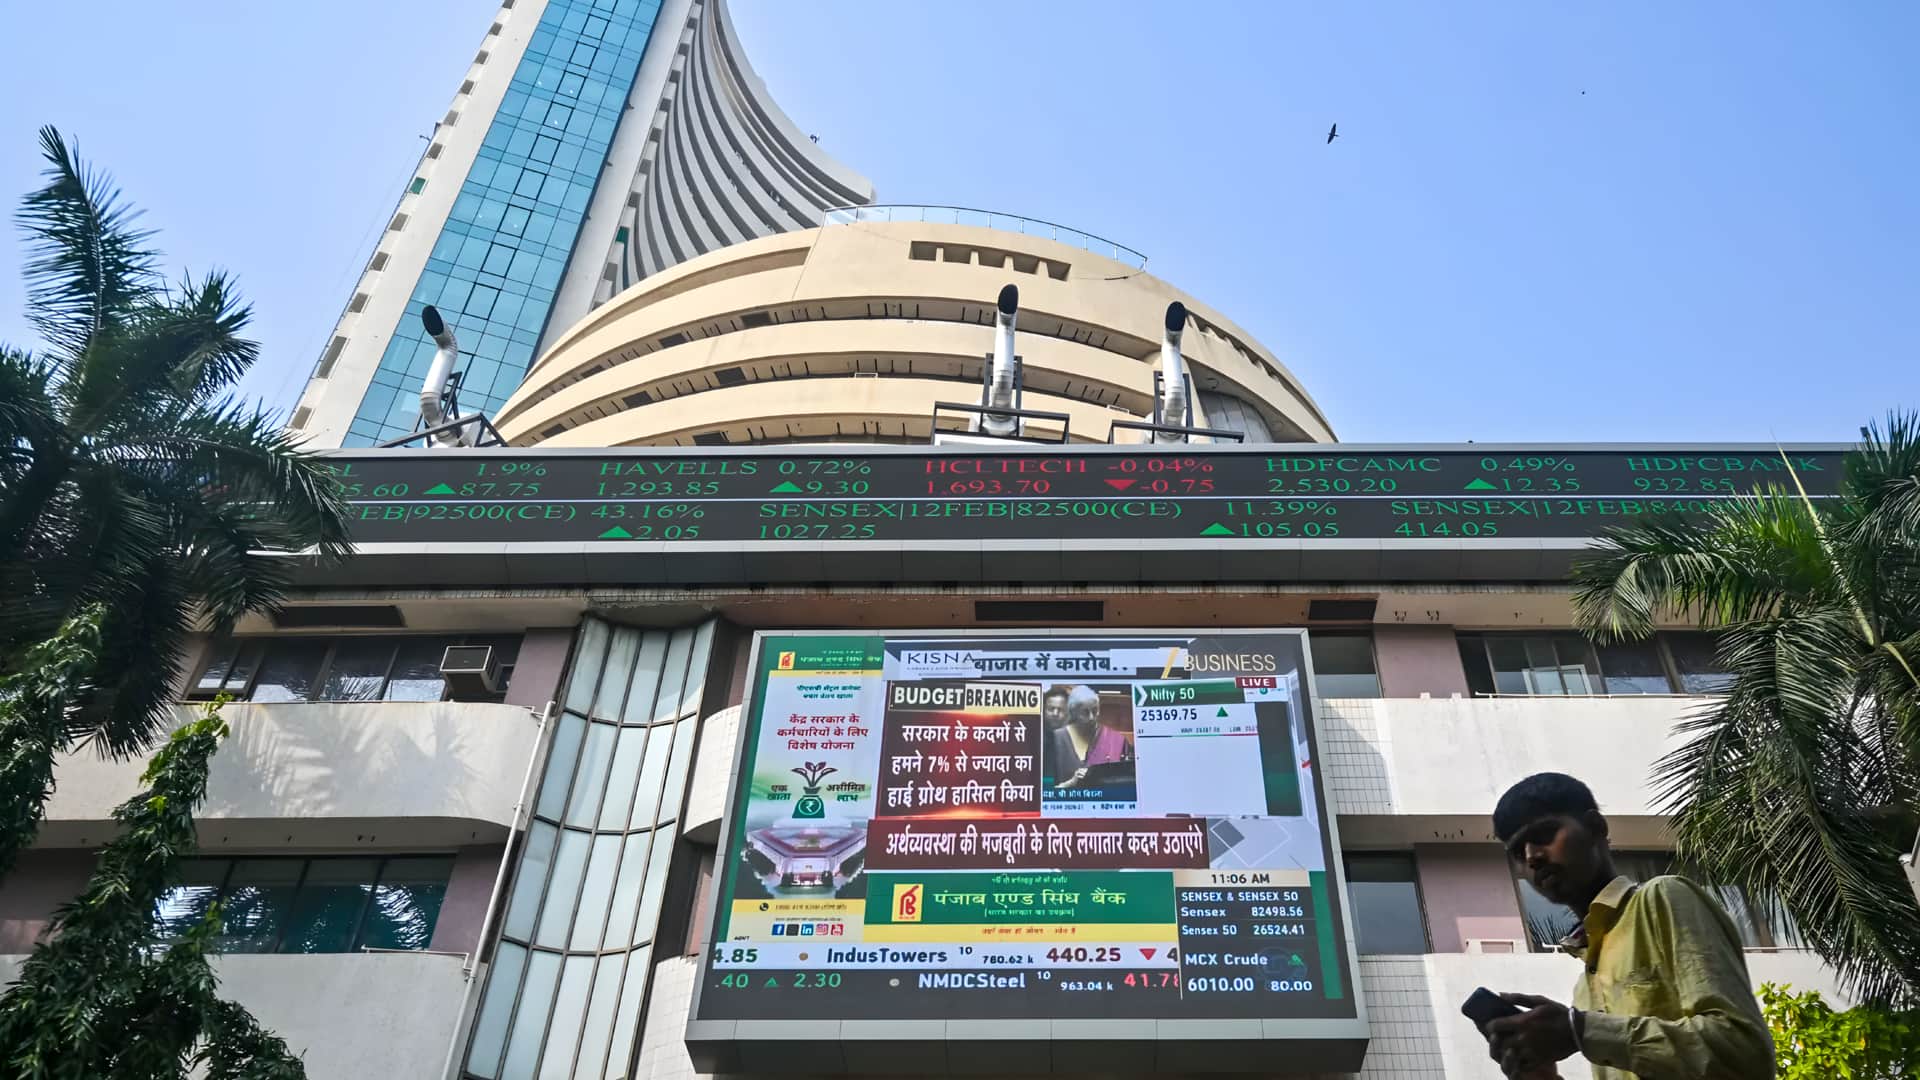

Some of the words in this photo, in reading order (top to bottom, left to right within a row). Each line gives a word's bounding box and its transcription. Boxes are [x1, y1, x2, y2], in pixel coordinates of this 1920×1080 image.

[477, 462, 547, 477] 1.9%
[600, 461, 757, 476] HAVELLS
[779, 459, 871, 475] 0.72%
[925, 459, 1086, 474] HCLTECH
[1108, 458, 1214, 473] -0.04%
[1266, 458, 1441, 472] HDFCAMC
[1481, 457, 1575, 472] 0.49%
[1626, 457, 1824, 471] HDFCBANK
[459, 482, 541, 496] 87.75
[598, 481, 720, 497] 1,293.85
[805, 480, 869, 495] 9.30
[927, 479, 1051, 495] 1,693.70
[1141, 479, 1215, 494] -0.75
[1268, 478, 1397, 495] 2,530.20
[1502, 477, 1580, 492] 12.35
[1633, 477, 1736, 492] 932.85
[591, 504, 705, 520] 43.16%
[1226, 501, 1337, 516] 11.39%
[634, 525, 700, 540] 2.05
[758, 524, 875, 539] 1027.25
[1240, 522, 1339, 537] 105.05
[1395, 521, 1498, 537] 414.05
[907, 652, 974, 665] KISNA
[974, 658, 1028, 672] बाजार
[1035, 653, 1051, 671] में
[1184, 654, 1276, 672] BUSINESS
[1241, 678, 1271, 688] LIVE
[894, 686, 963, 705] BUDGET
[966, 688, 1039, 708] BREAKING
[1151, 688, 1176, 703] Nifty
[1180, 688, 1195, 700] 50
[811, 716, 845, 724] सरकार
[849, 713, 860, 724] के
[1141, 708, 1197, 722] 25369.75
[834, 726, 844, 737] के
[847, 726, 869, 737] लिए
[902, 725, 950, 742] सरकार
[955, 720, 969, 742] के
[973, 721, 1010, 743] कदमों
[1014, 721, 1026, 742] से
[788, 739, 817, 750] विशेष
[820, 740, 855, 750] योजना
[891, 750, 923, 775] हमने
[928, 756, 950, 773] 7%
[955, 750, 968, 773] से
[972, 756, 1010, 773] ज्यादा
[1014, 755, 1033, 772] का
[888, 781, 914, 807] हाई
[918, 781, 947, 806] ग्रोथ
[952, 780, 996, 805] हासिल
[1000, 779, 1034, 802] किया
[886, 824, 956, 855] अर्थव्यवस्था
[960, 824, 978, 855] की
[982, 824, 1026, 864] मजबूती
[1030, 824, 1043, 855] के
[1047, 824, 1073, 858] लिए
[1077, 832, 1123, 855] लगातार
[1127, 832, 1158, 856] कदम
[1162, 824, 1203, 858] उठाएंगे
[1212, 874, 1247, 884] 11:06
[1251, 874, 1270, 884] AM
[934, 889, 986, 905] पंजाब
[992, 892, 1035, 909] एण्ड
[1040, 889, 1080, 905] सिंध
[1091, 887, 1127, 905] बैंक
[1181, 892, 1222, 902] SENSEX
[1226, 892, 1234, 902] &
[1238, 892, 1280, 902] SENSEX
[1283, 891, 1299, 901] 50
[1181, 907, 1226, 917] Sensex
[1251, 906, 1304, 917] 82498.56
[1182, 925, 1218, 935] Sensex
[1222, 925, 1237, 935] 50
[1253, 925, 1305, 935] 26524.41
[714, 948, 758, 963] 4.85
[827, 947, 948, 963] IndusTowers
[959, 946, 973, 955] 10
[982, 955, 1023, 964] 780.62
[1027, 955, 1034, 964] k
[1046, 947, 1121, 962] 440.25
[1185, 954, 1218, 966] MCX
[1224, 953, 1268, 966] Crude
[793, 973, 841, 988] 2.30
[918, 973, 1025, 988] NMDCSteel
[1037, 971, 1051, 980] 10
[1060, 982, 1102, 991] 963.04
[1107, 982, 1113, 991] k
[1187, 978, 1254, 992] 6010.00
[1270, 981, 1313, 992] 80.00
